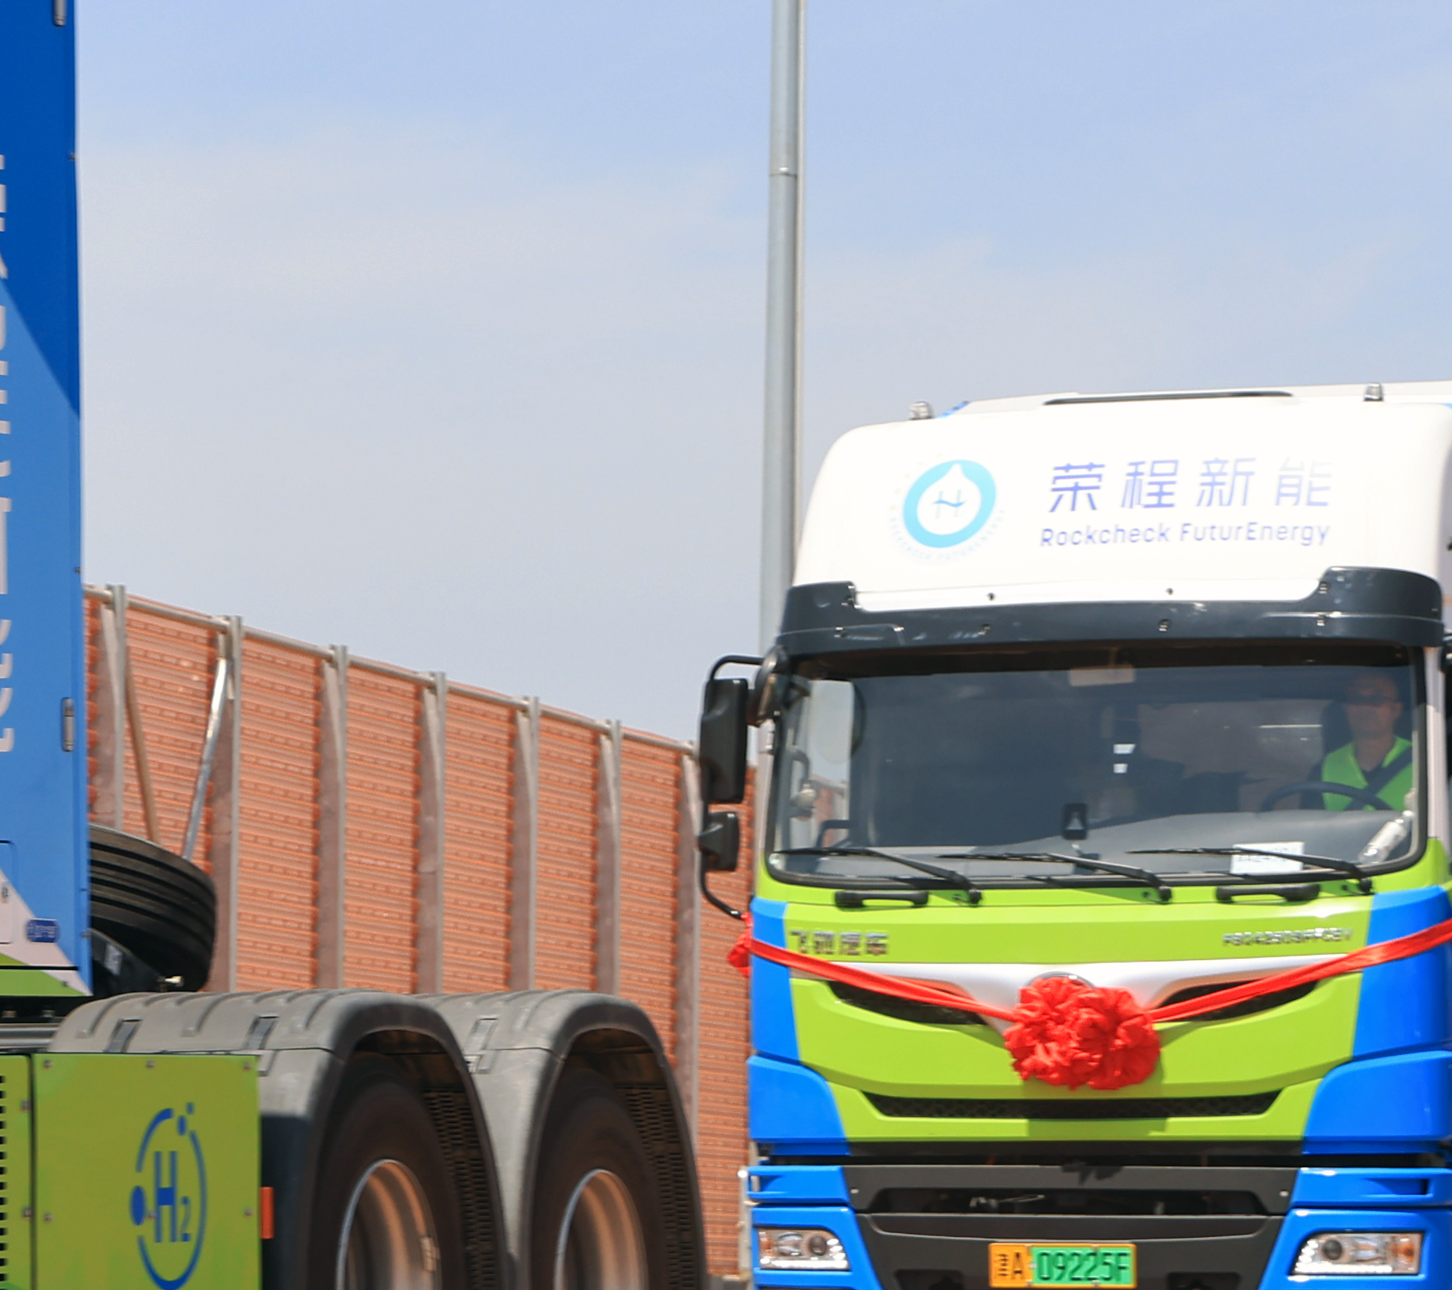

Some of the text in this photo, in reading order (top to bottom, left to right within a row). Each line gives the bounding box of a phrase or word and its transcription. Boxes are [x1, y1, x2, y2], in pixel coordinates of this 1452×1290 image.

[1049, 456, 1333, 513] 荣程新能
[1040, 521, 1330, 547] Rockcheck FuturEnergy
